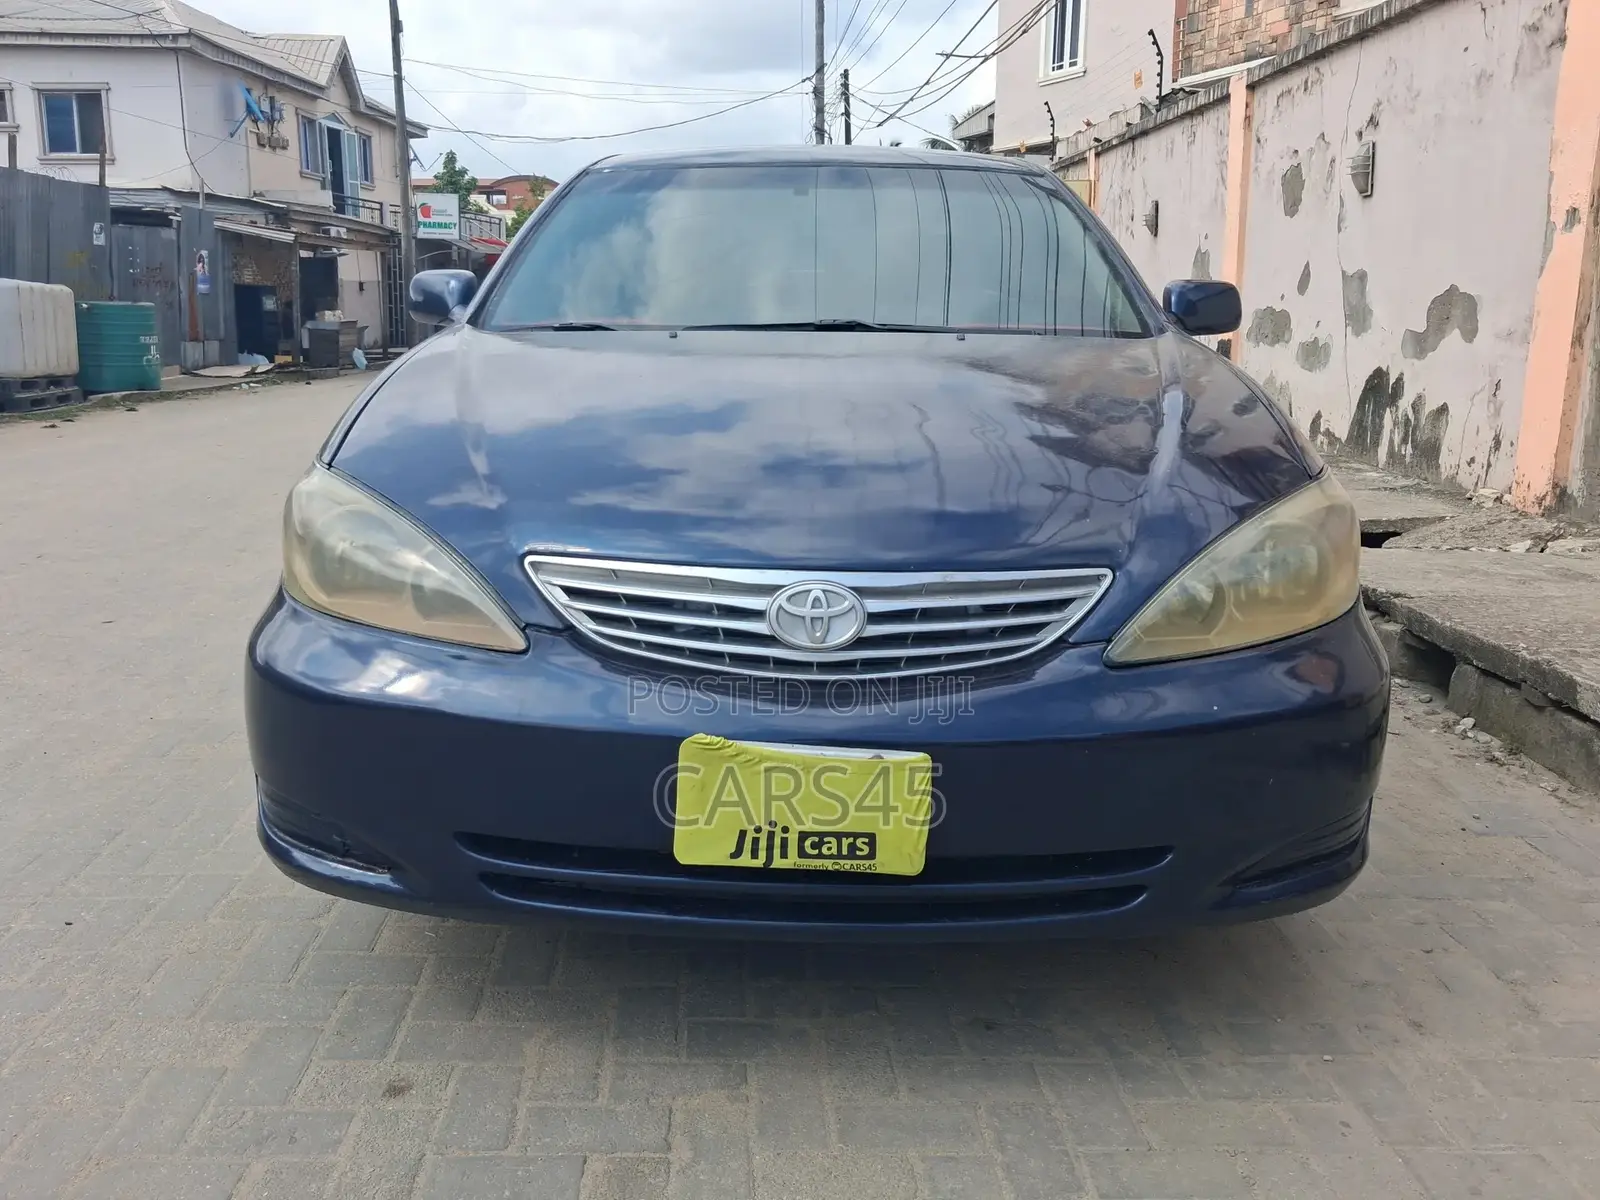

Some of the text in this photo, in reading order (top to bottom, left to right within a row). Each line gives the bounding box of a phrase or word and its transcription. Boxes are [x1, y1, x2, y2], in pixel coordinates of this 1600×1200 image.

[417, 221, 457, 230] PHARMACY
[729, 820, 870, 868] Jiji cars
[793, 861, 878, 872] formerly CARS45
